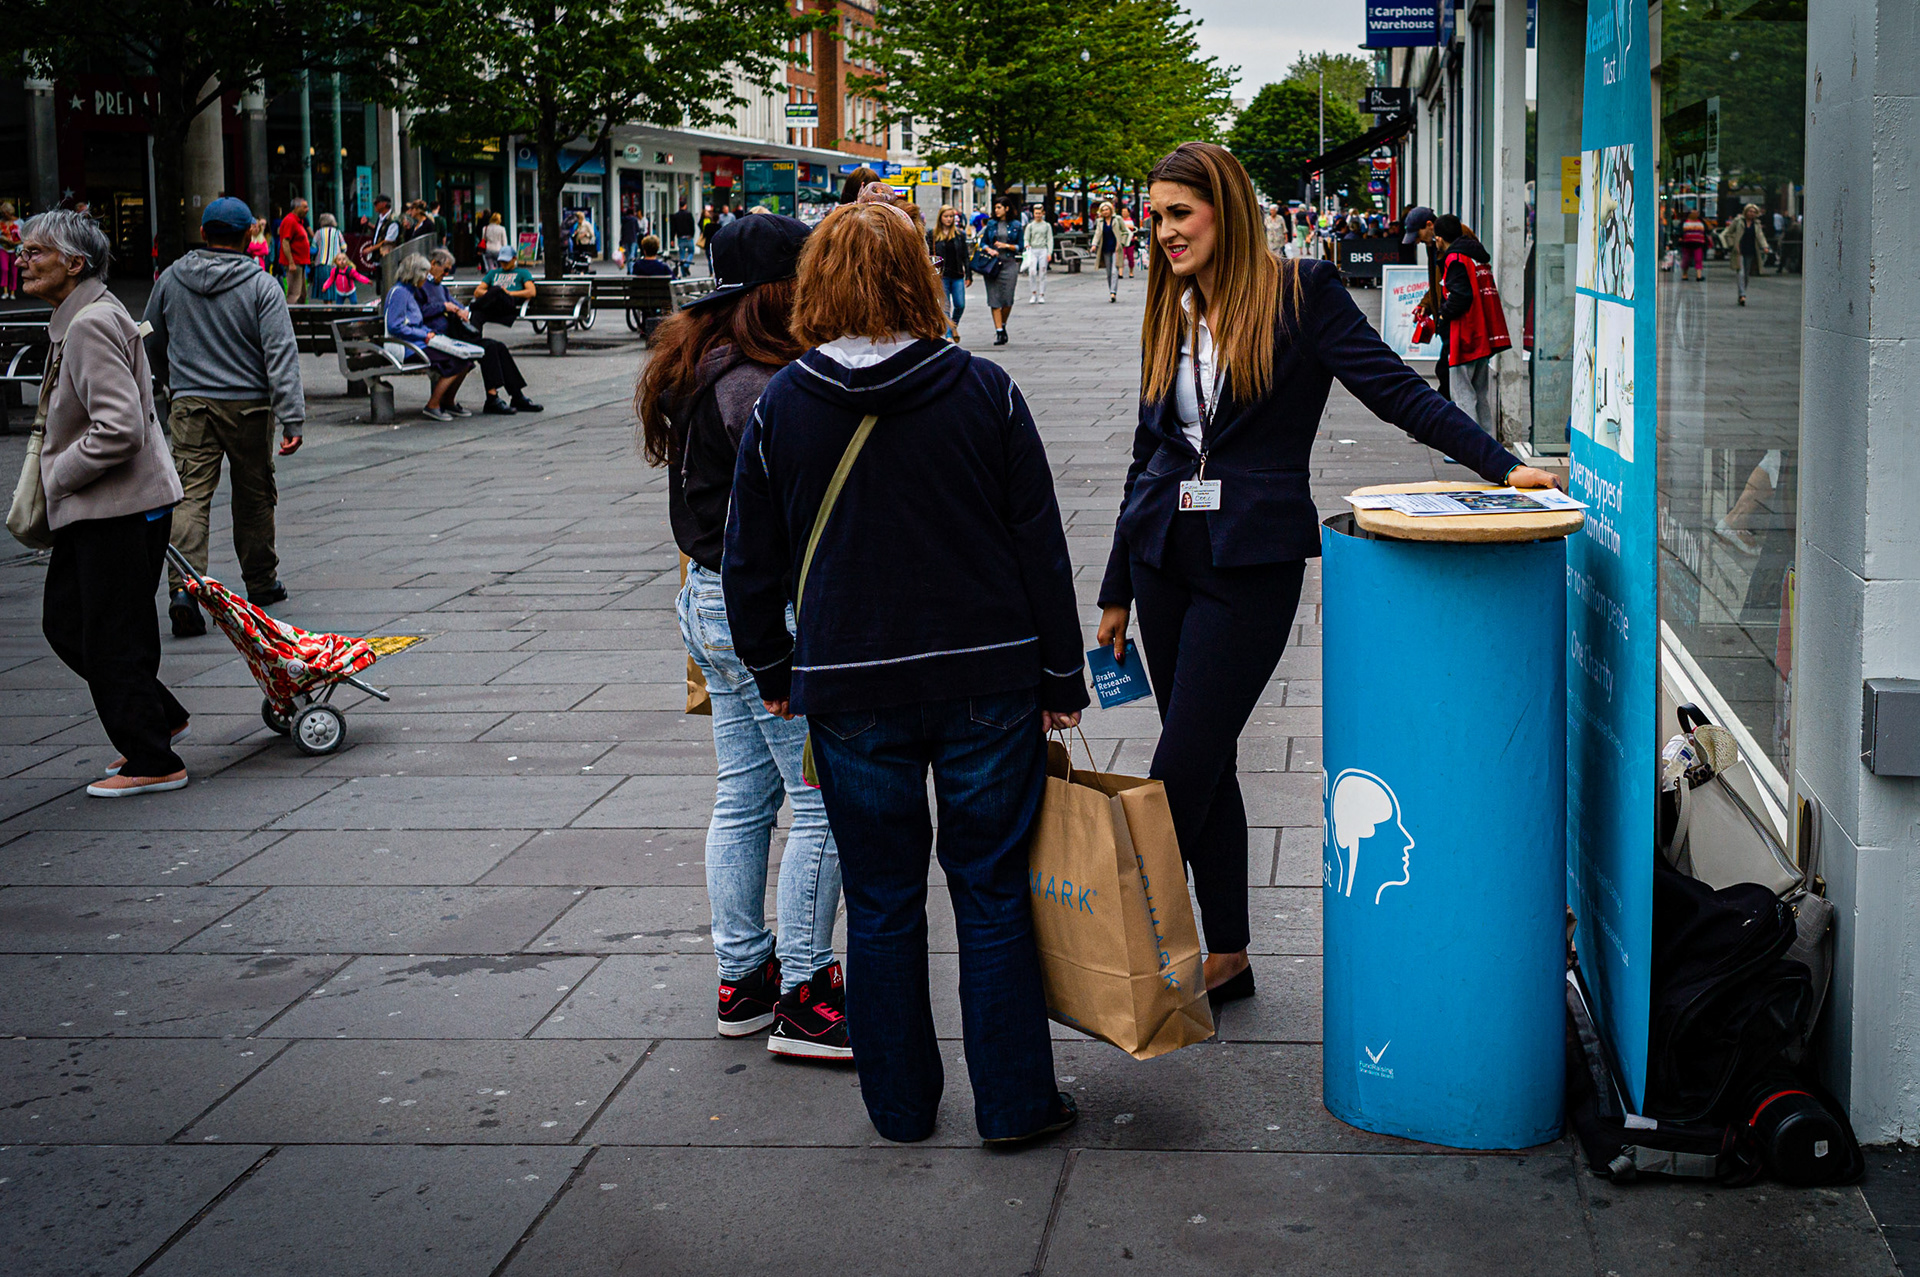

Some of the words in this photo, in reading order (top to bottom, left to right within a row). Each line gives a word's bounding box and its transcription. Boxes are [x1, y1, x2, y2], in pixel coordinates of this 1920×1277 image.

[1375, 6, 1435, 18] Carphone
[1369, 20, 1435, 29] Warehouse
[1350, 252, 1373, 263] BHS
[1393, 286, 1405, 296] WE
[1406, 280, 1430, 293] COMP
[1398, 288, 1427, 302] BROADB
[1569, 451, 1585, 486] Over
[1594, 468, 1617, 513] types
[1617, 481, 1623, 514] of
[1586, 513, 1621, 558] condition
[1607, 599, 1629, 645] people
[1571, 629, 1584, 668] One
[1584, 644, 1614, 703] Charity
[1095, 670, 1117, 683] Brain
[1097, 674, 1132, 691] Research
[1100, 686, 1121, 699] Trust
[1029, 867, 1094, 915] MARK
